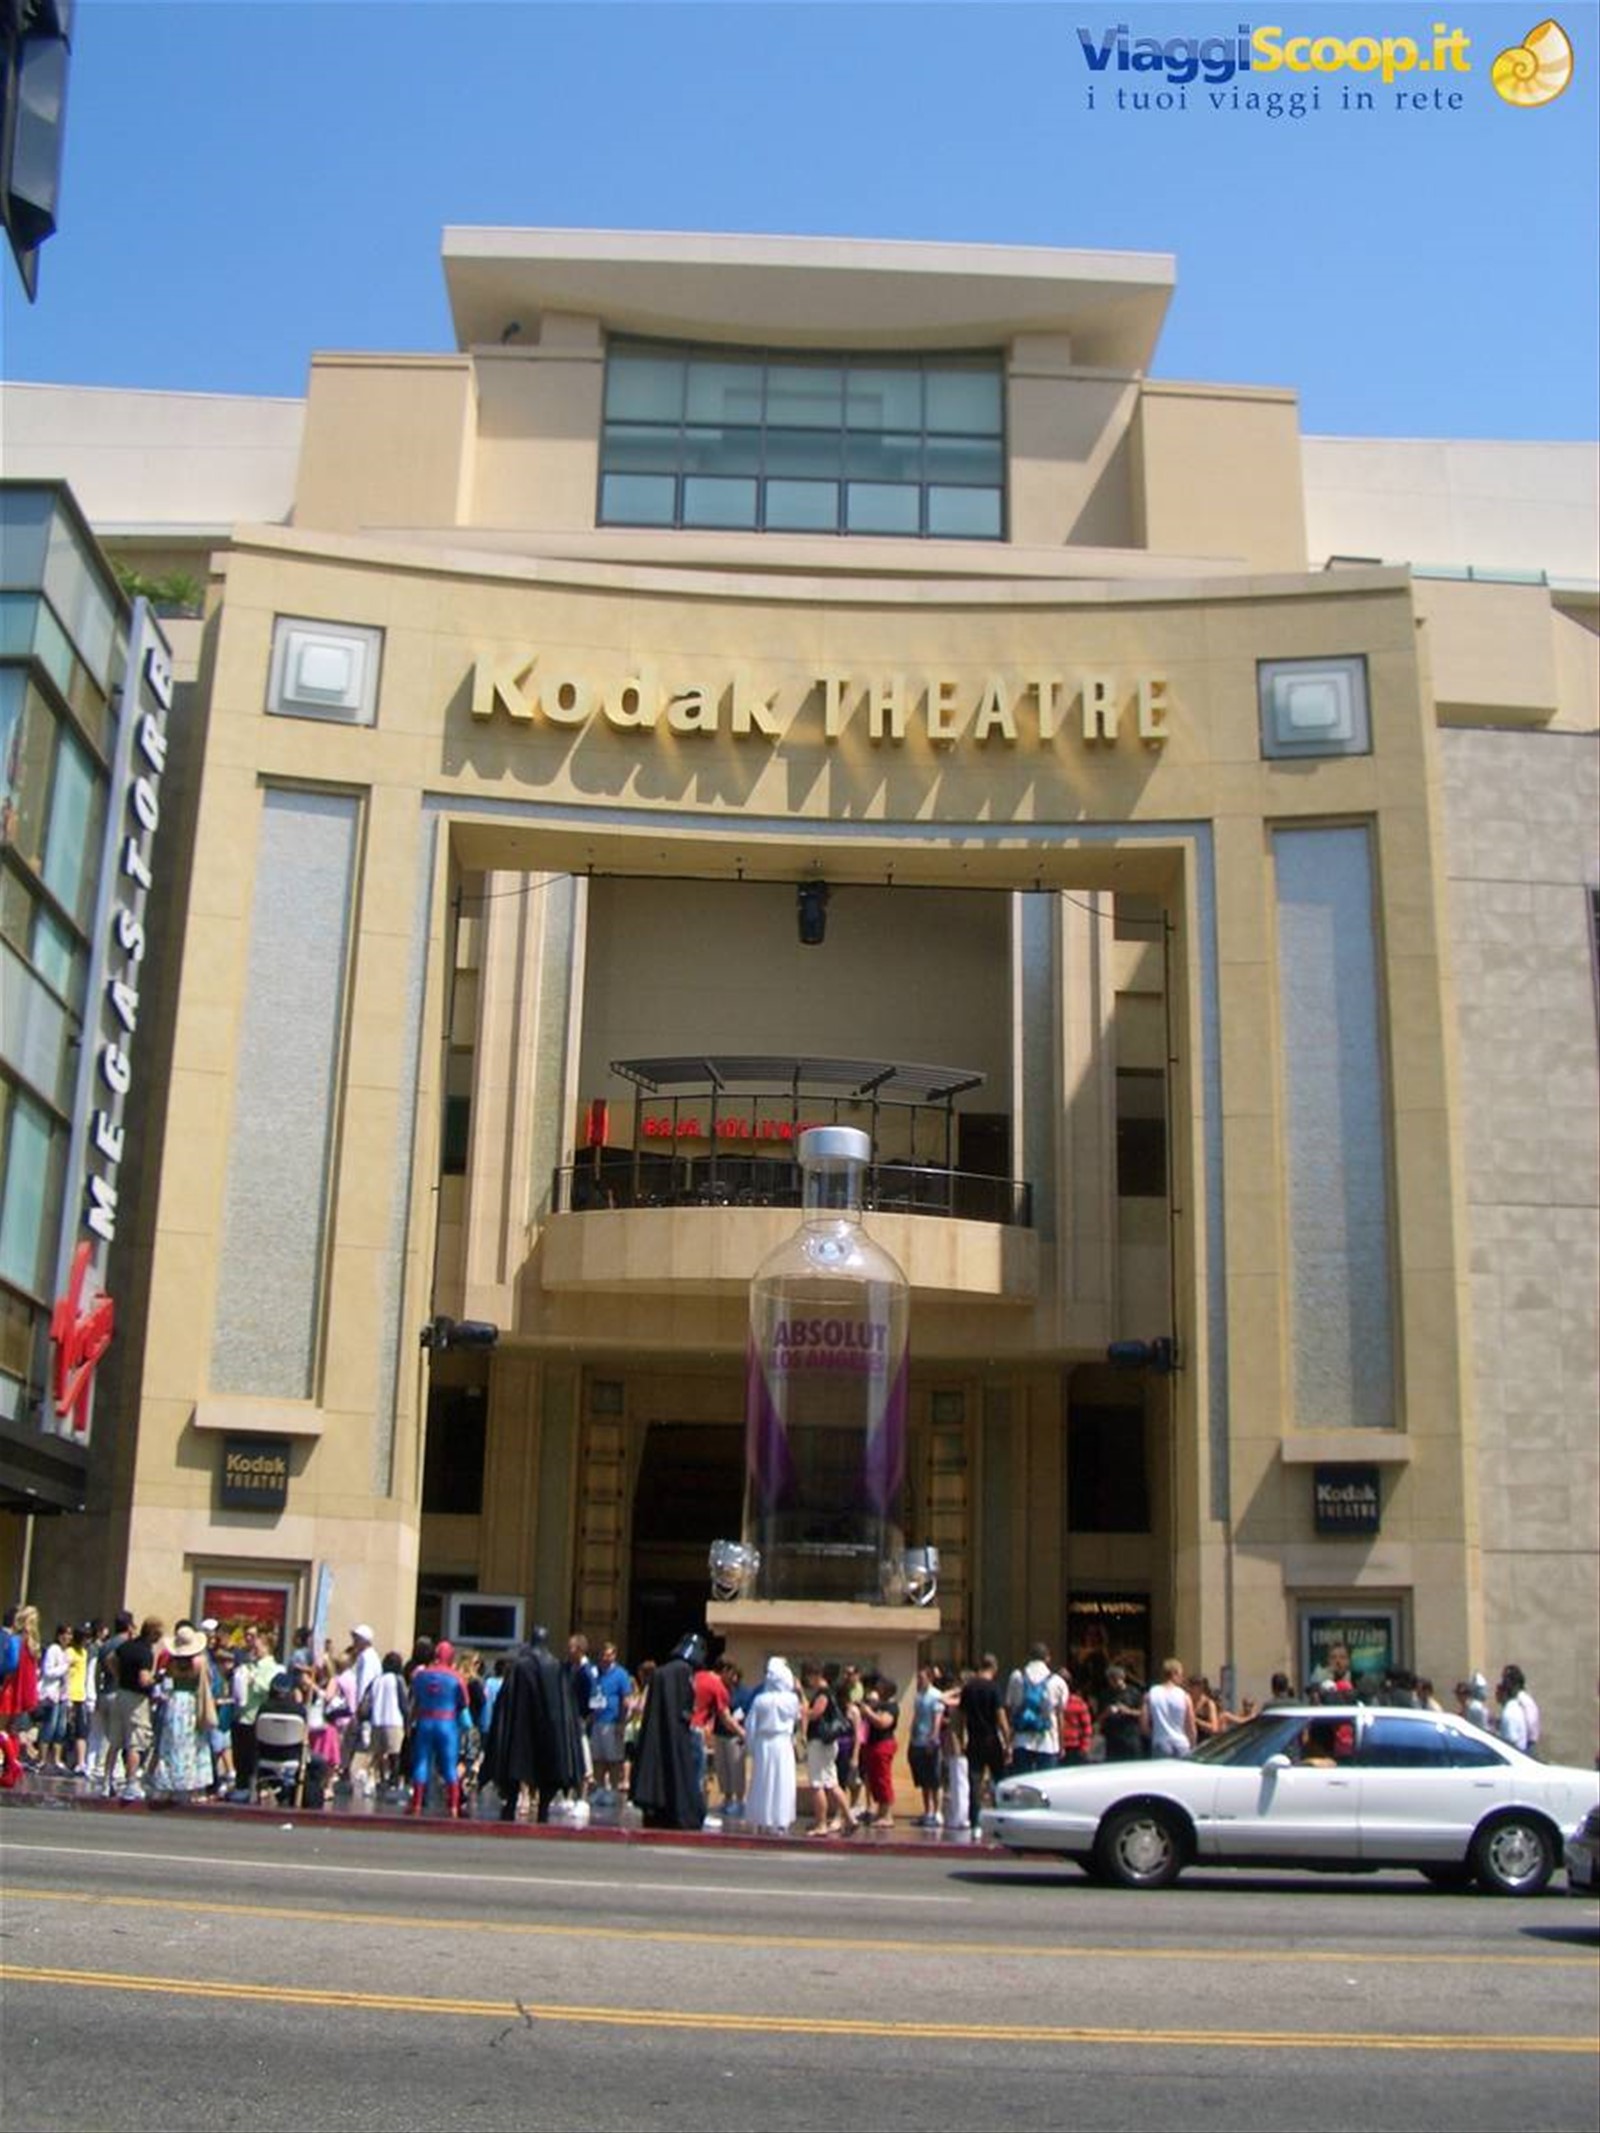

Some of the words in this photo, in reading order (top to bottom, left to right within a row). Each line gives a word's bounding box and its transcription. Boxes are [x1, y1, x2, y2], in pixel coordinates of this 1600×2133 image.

[470, 655, 782, 742] Kodak
[815, 672, 1170, 748] THEATRE
[86, 646, 174, 1241] MEGASTORE
[773, 1319, 888, 1351] ABSOLUT
[226, 1453, 287, 1473] Kodak
[1317, 1484, 1377, 1501] Kodak
